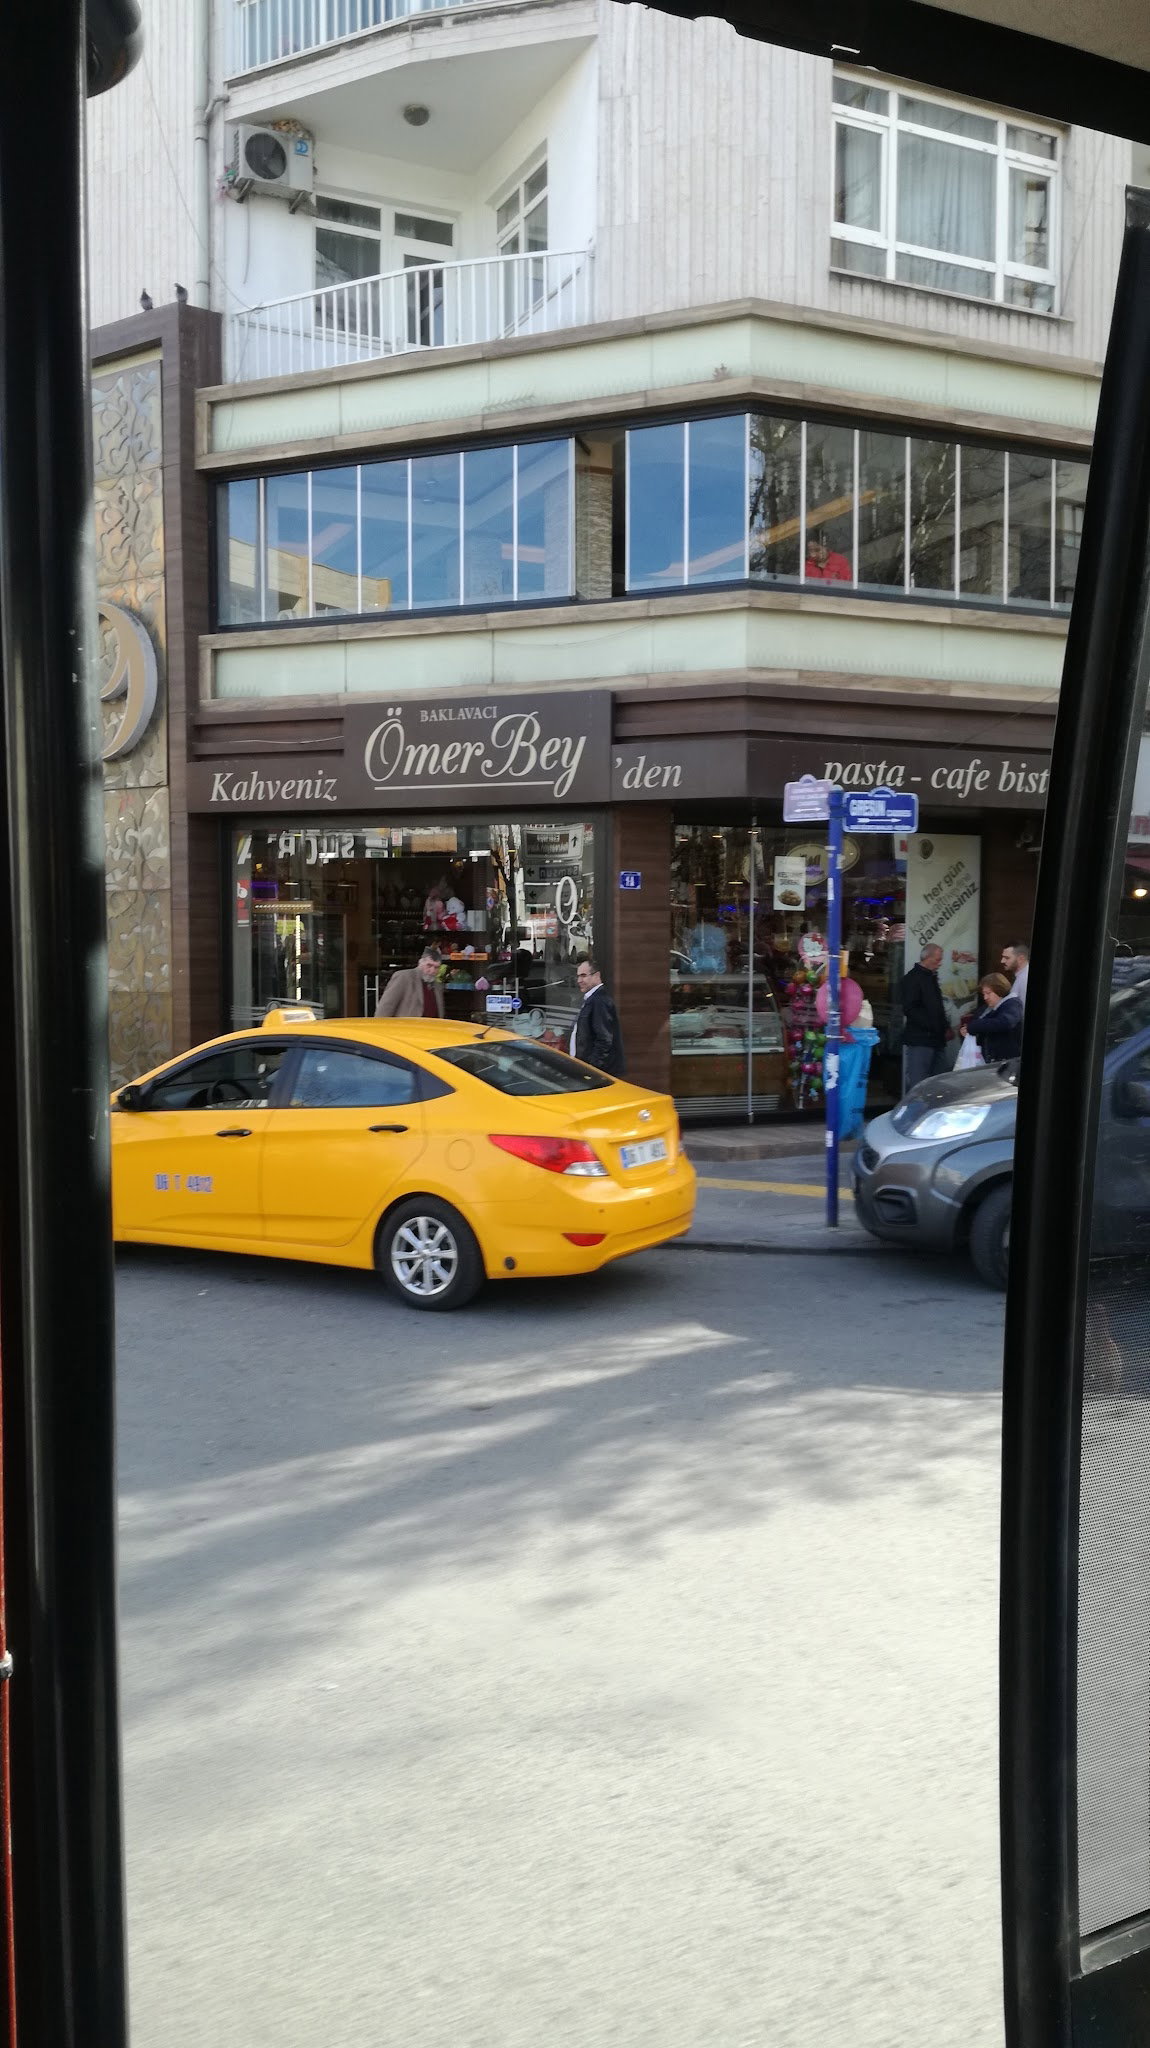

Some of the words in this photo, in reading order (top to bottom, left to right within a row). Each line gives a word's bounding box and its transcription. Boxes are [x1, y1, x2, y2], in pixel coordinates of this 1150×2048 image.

[420, 706, 497, 724] BAKLAVACI
[209, 769, 338, 802] Kahveniz
[364, 707, 485, 782] Ömer
[481, 711, 587, 798] Bey
[824, 760, 906, 787] pasta
[930, 759, 990, 798] cafe
[923, 881, 944, 904] her
[943, 860, 966, 887] gün
[918, 882, 979, 946] davetlisiniz
